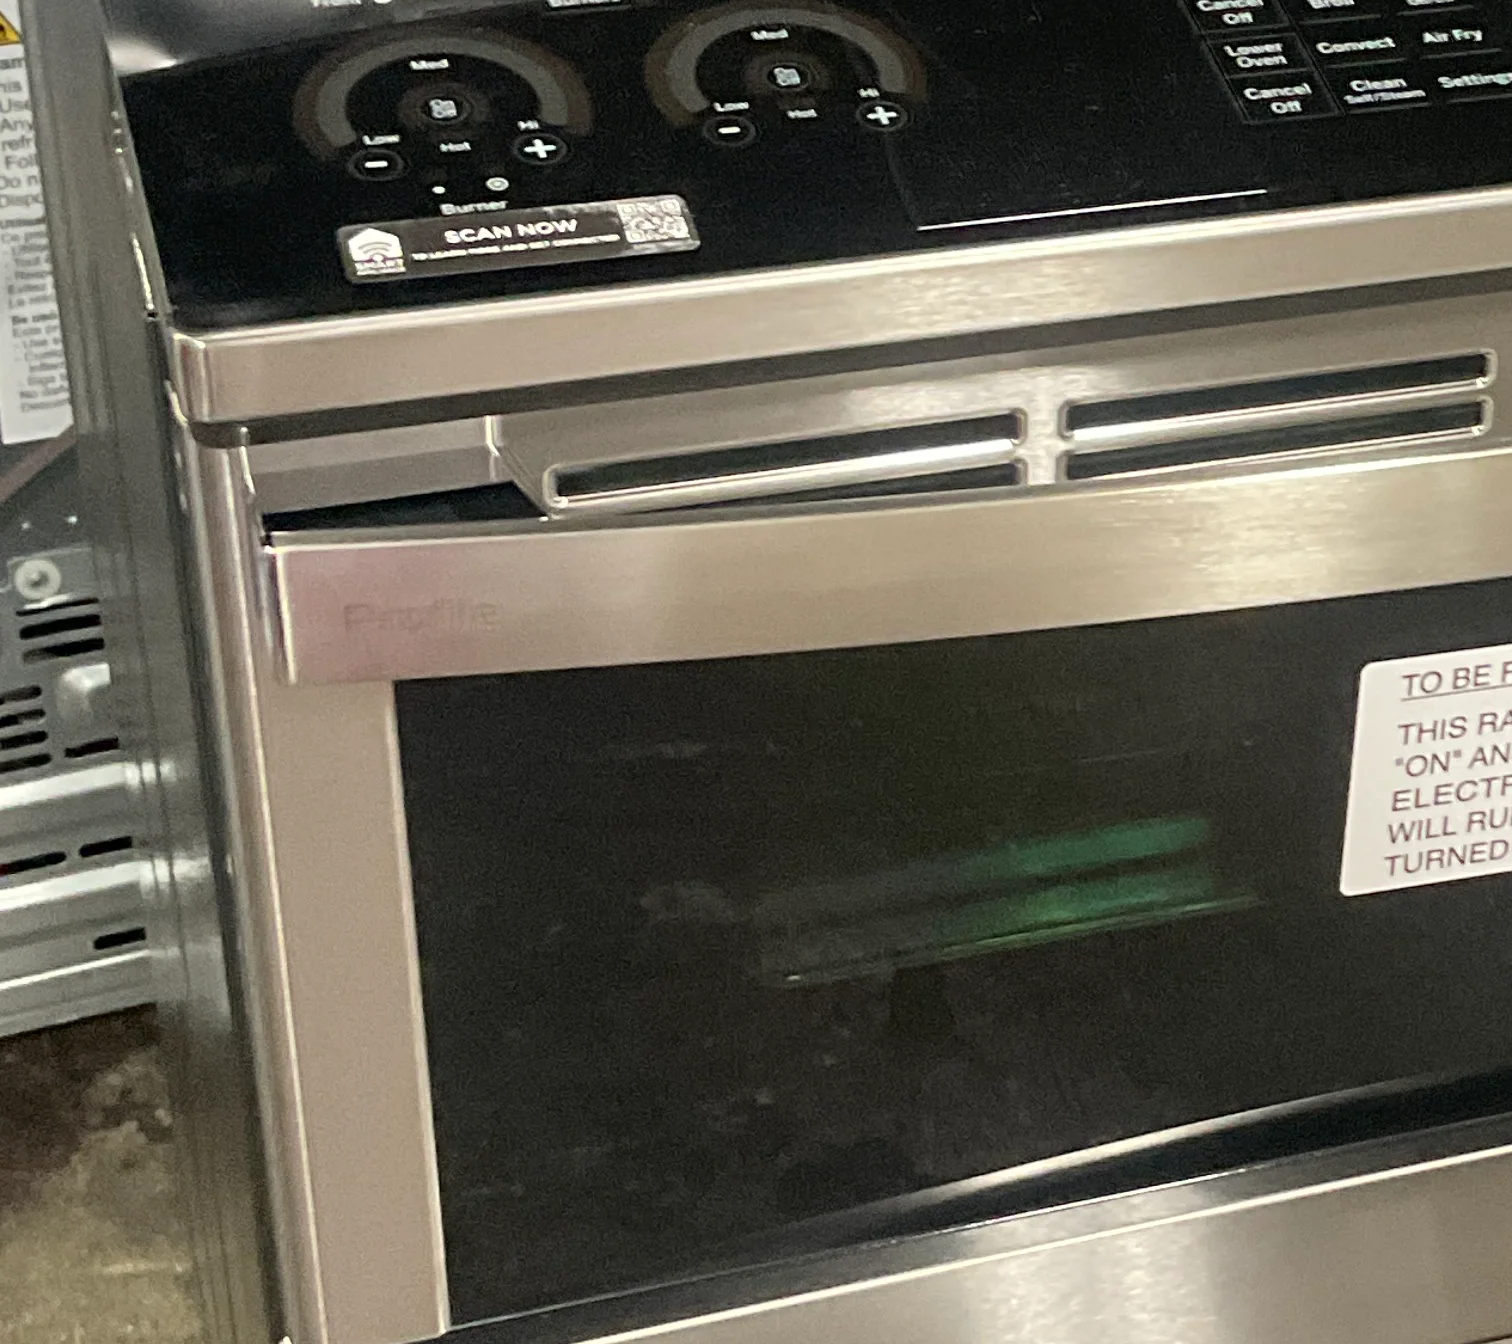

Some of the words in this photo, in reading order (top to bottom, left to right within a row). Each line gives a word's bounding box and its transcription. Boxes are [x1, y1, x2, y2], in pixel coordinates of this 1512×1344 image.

[1223, 42, 1284, 57] Lower
[1315, 37, 1397, 54] Convect
[1236, 55, 1289, 68] Oven
[1243, 82, 1313, 100] Cancel
[439, 200, 509, 216] Burner
[444, 225, 513, 245] SCAN
[517, 218, 579, 238] NOW
[1401, 671, 1442, 696] TO
[1452, 664, 1492, 690] BE
[1398, 715, 1468, 746] THIS
[1395, 749, 1463, 778] "ON"
[1387, 816, 1457, 845] WILL
[1384, 839, 1510, 877] TURNED
